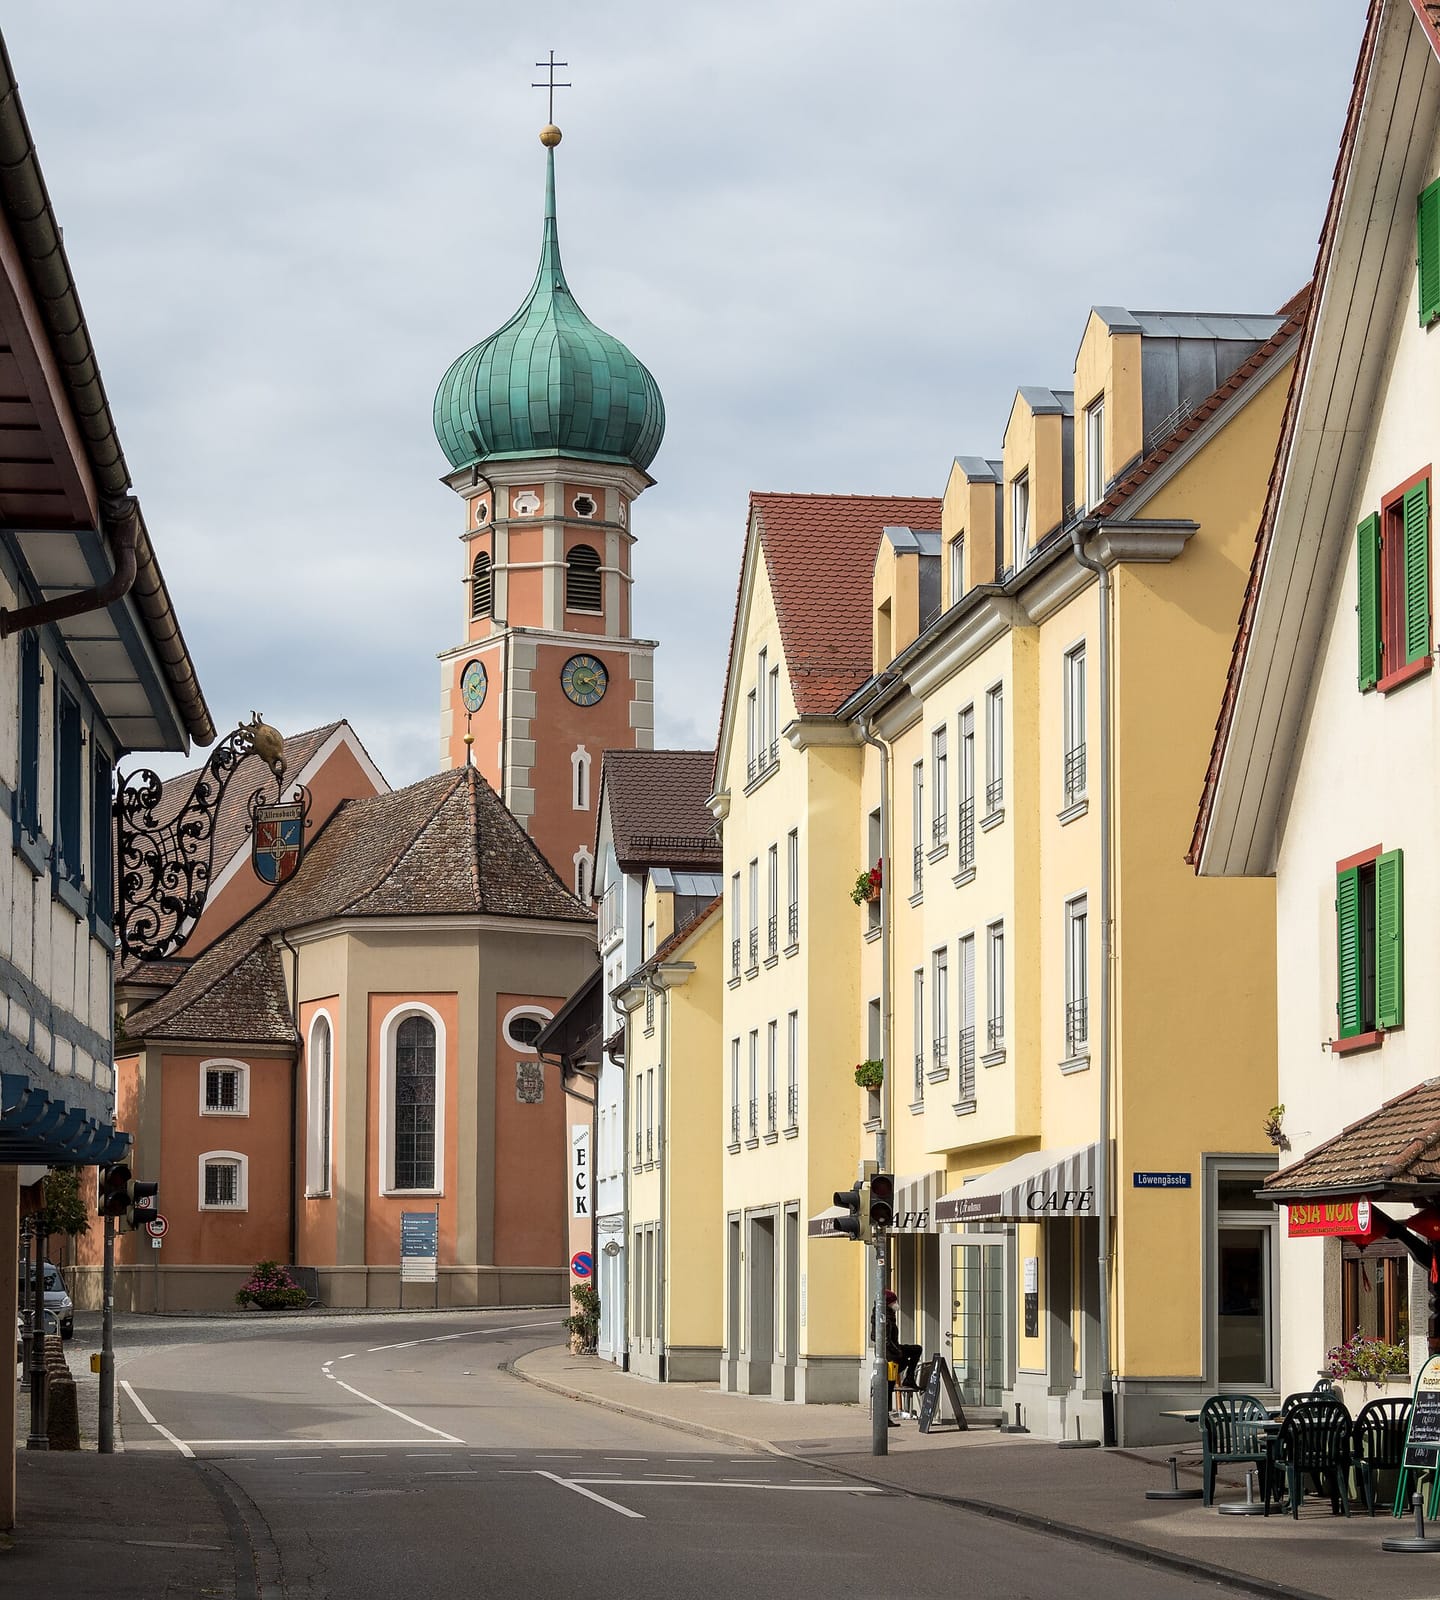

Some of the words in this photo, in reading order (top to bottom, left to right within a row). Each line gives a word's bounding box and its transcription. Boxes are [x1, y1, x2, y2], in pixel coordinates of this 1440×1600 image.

[576, 1148, 588, 1214] ECK
[1138, 1174, 1187, 1187] Löwengässle
[1026, 1185, 1094, 1211] CAFÉ
[886, 1207, 930, 1228] AFÉ
[1290, 1202, 1321, 1225] ASIA
[1325, 1200, 1355, 1222] WOK
